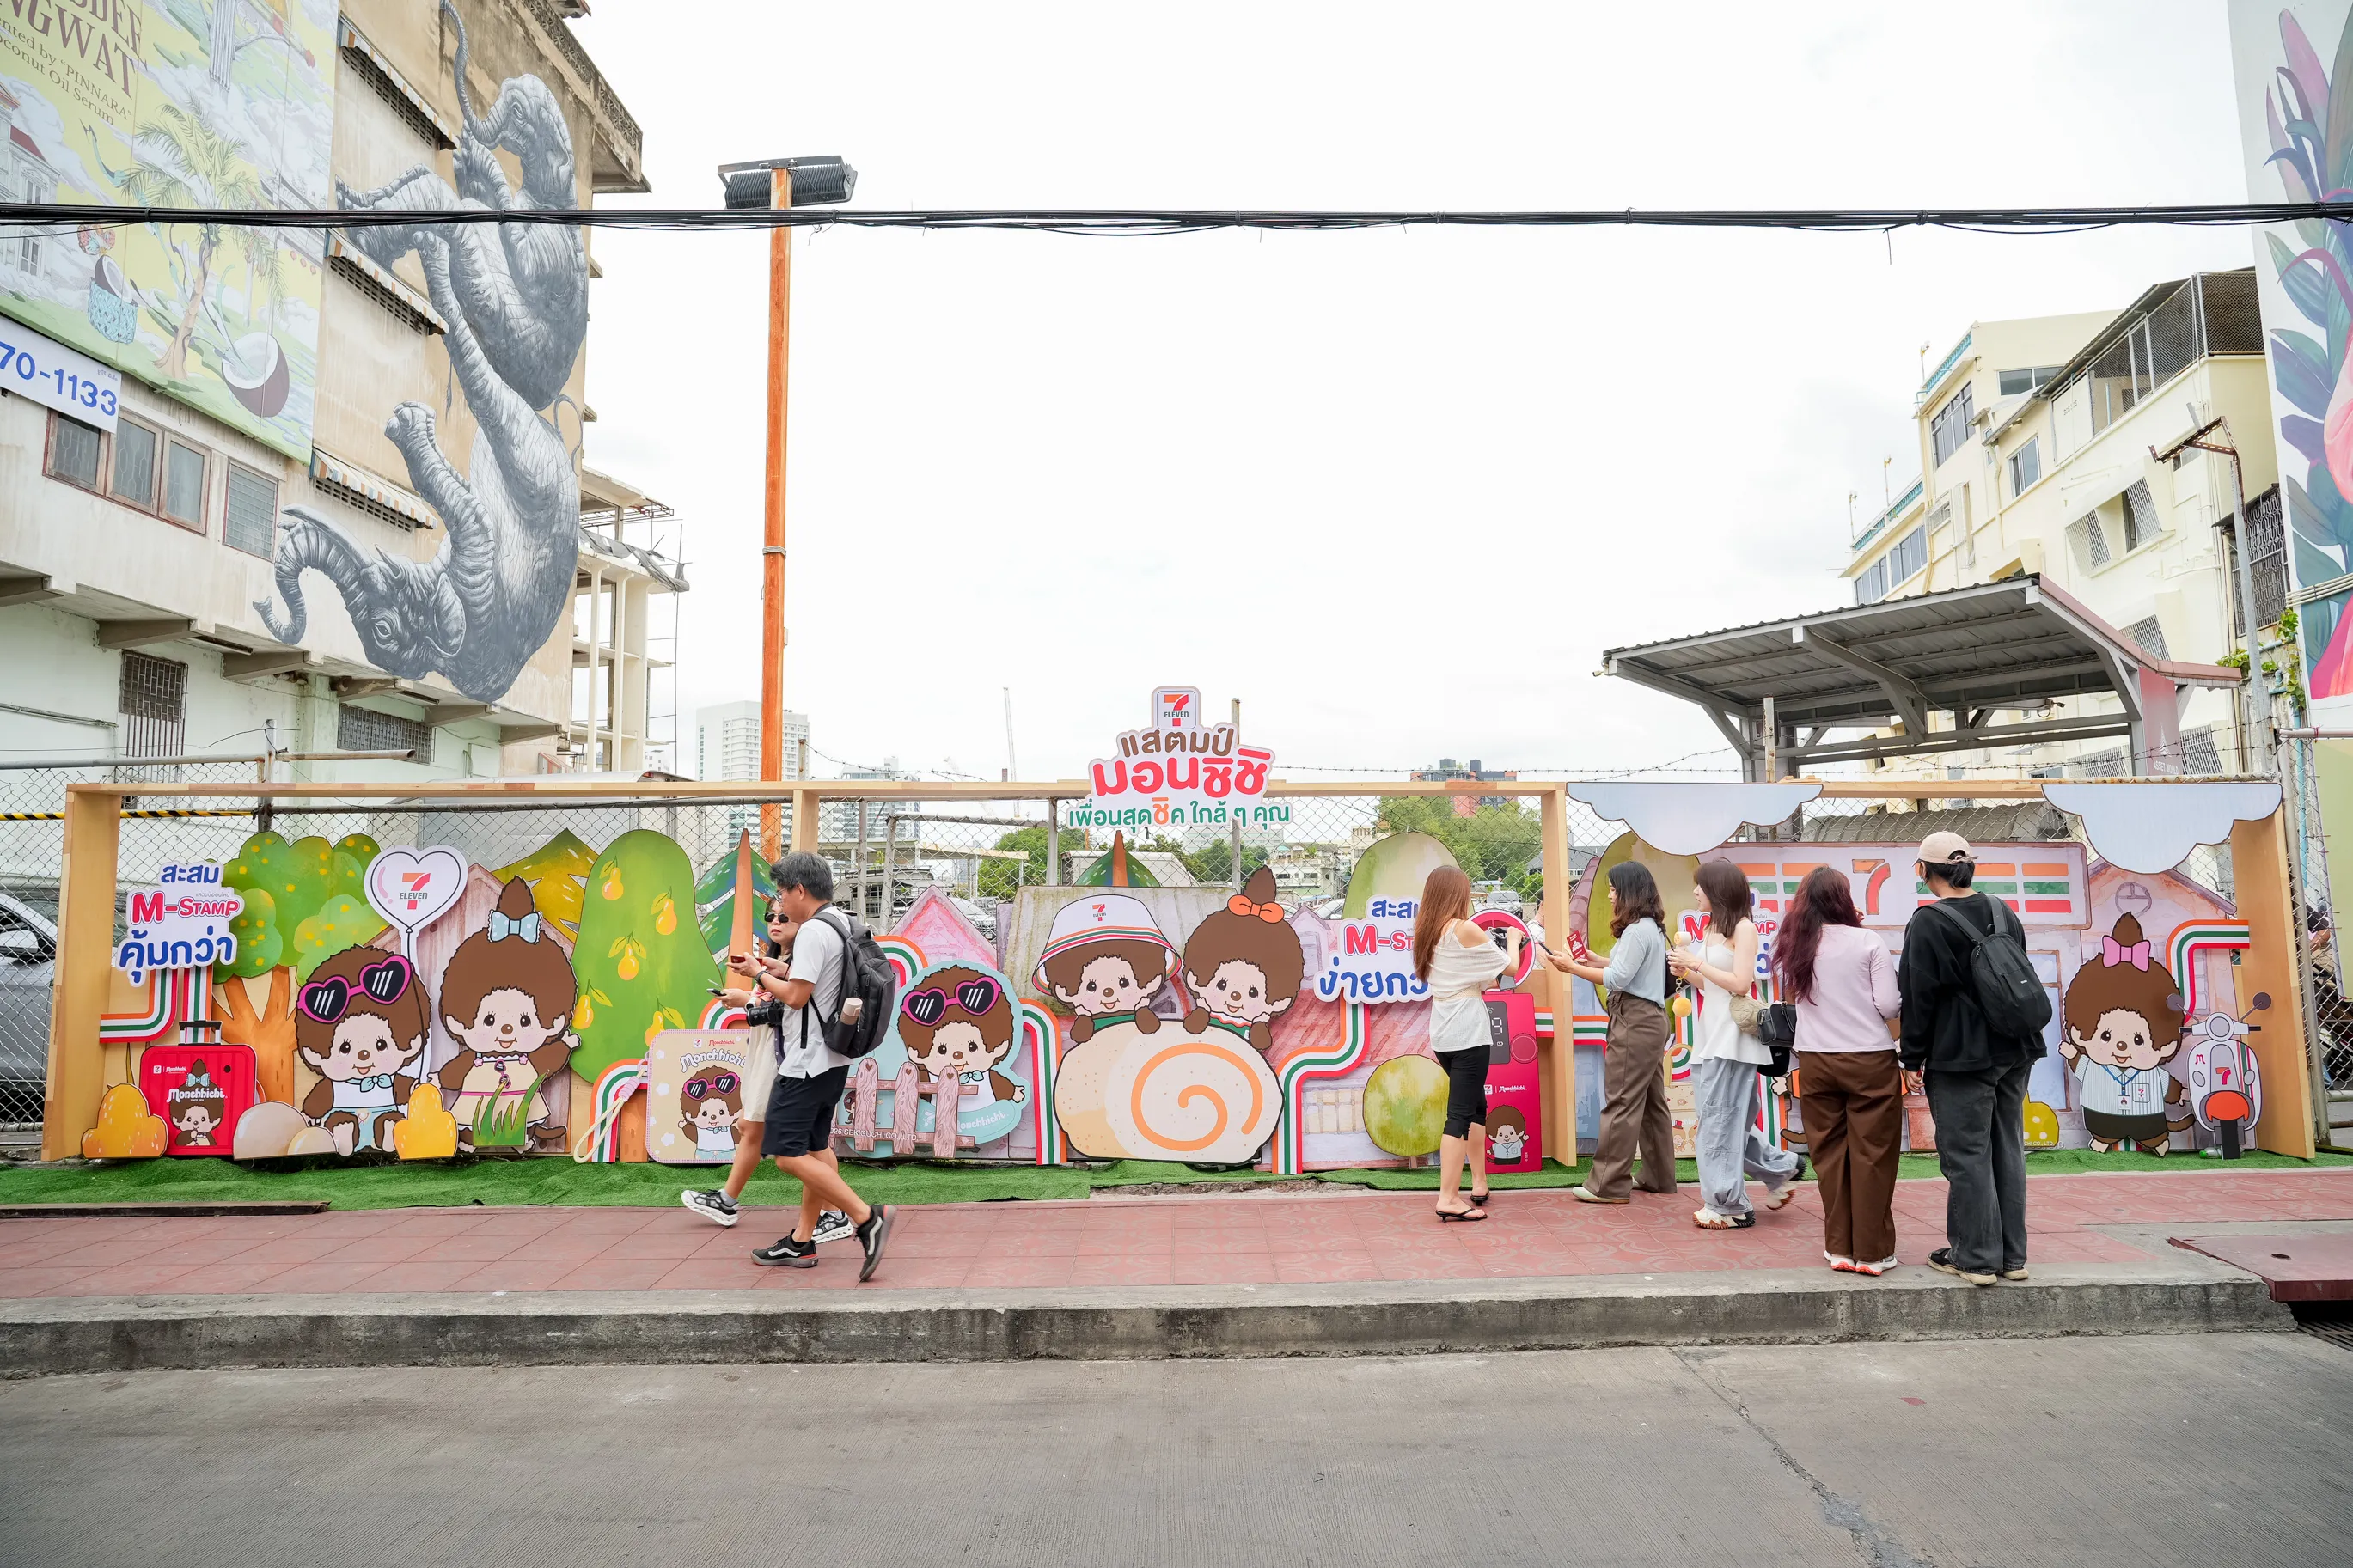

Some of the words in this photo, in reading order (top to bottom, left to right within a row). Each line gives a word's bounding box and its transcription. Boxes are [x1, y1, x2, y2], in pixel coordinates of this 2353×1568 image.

[40, 43, 57, 65] by
[0, 35, 45, 75] conut
[49, 70, 69, 93] Oil
[73, 88, 113, 125] Serum
[1121, 727, 1234, 758] แสตมป์
[1092, 748, 1274, 799] มอนชิชิ
[1254, 805, 1289, 830] คุณ
[161, 864, 220, 884] สะสม
[119, 925, 234, 984] คุ้มกว่า
